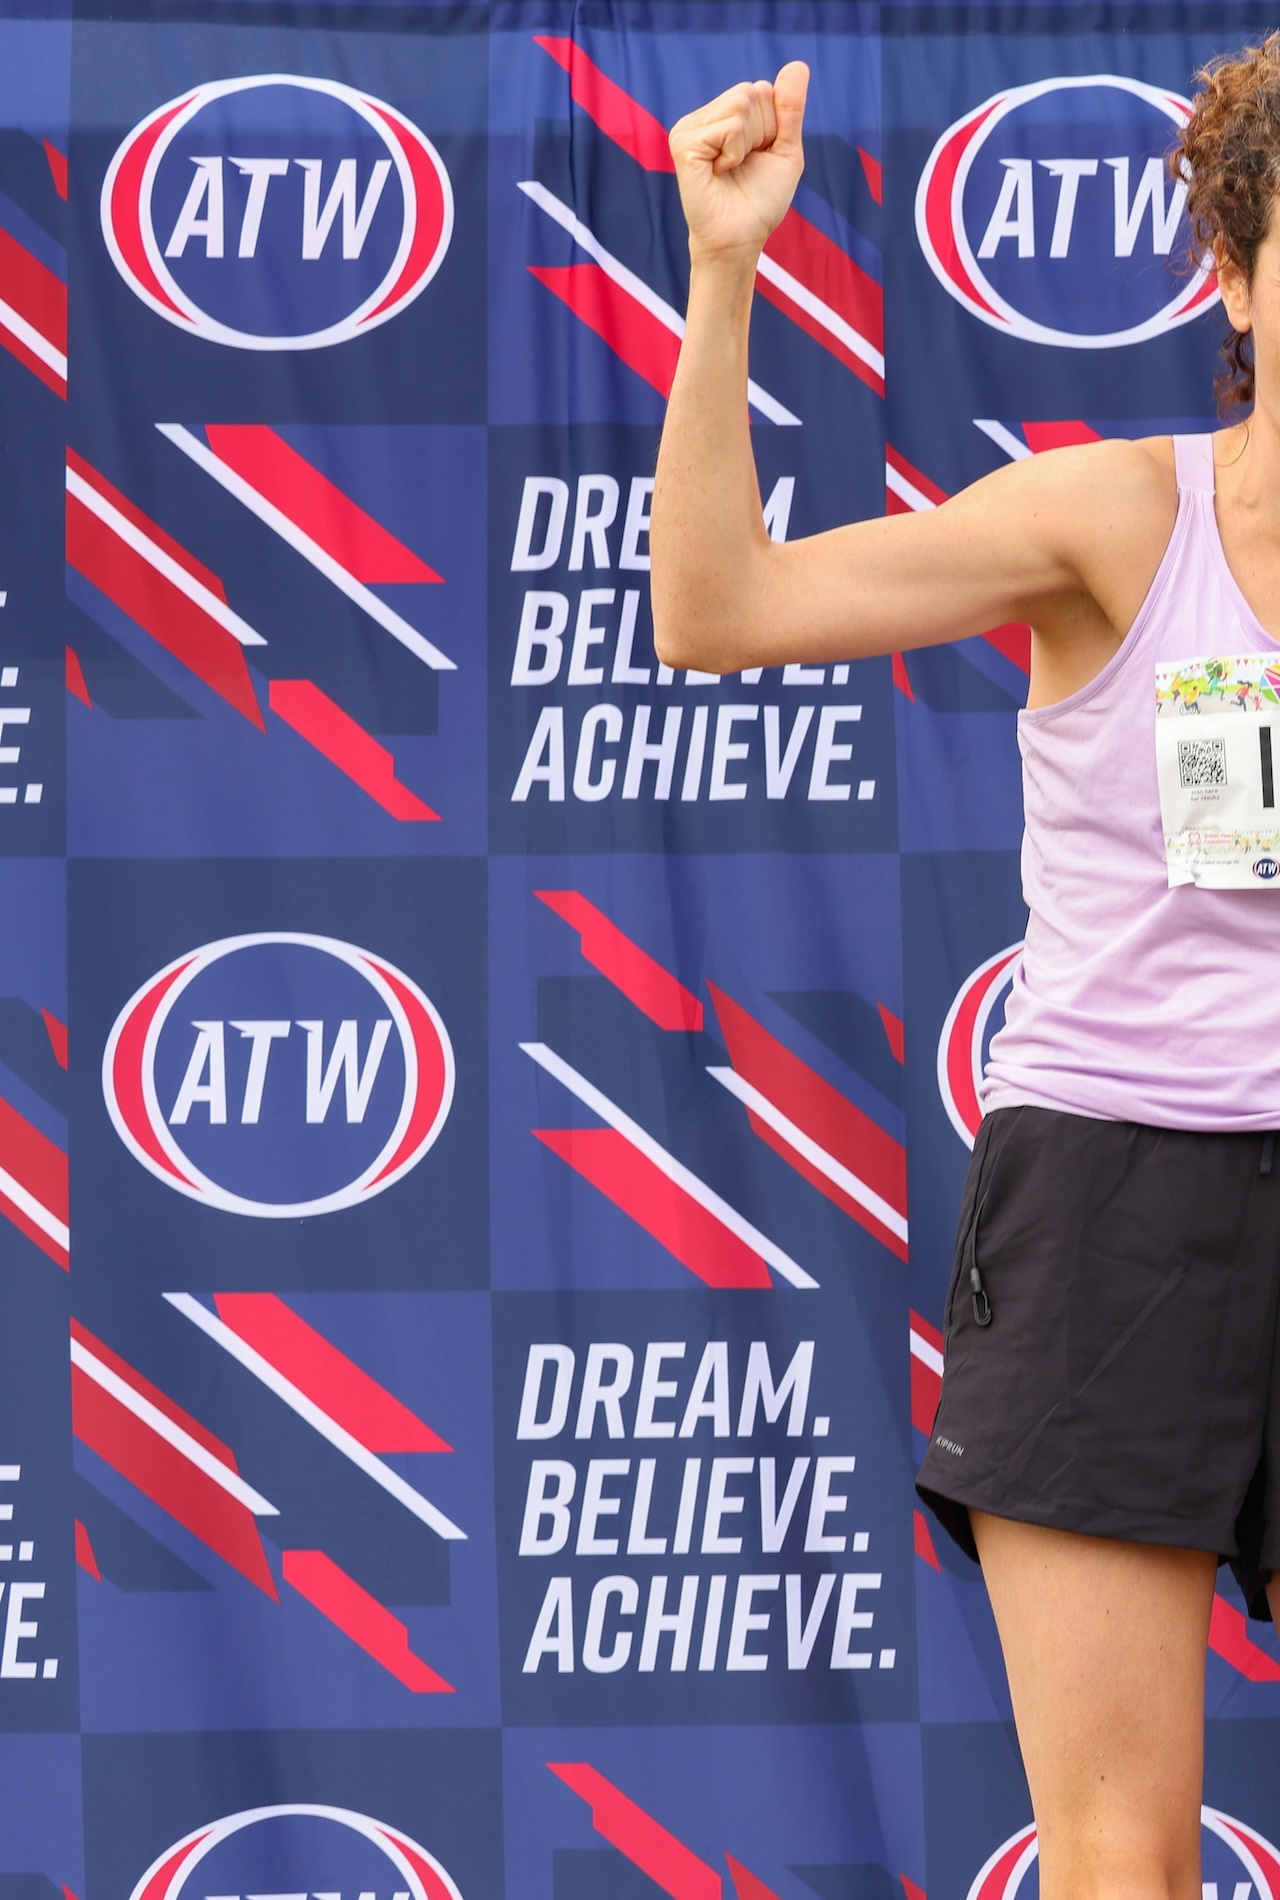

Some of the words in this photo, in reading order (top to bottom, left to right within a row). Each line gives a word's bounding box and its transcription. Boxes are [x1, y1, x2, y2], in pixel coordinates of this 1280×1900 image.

[164, 156, 392, 260] ATW
[977, 156, 1193, 259] ATW
[511, 703, 876, 802] ACHIEVE.
[1256, 864, 1278, 875] ATW
[169, 1019, 393, 1125] ATW
[516, 1341, 830, 1440] DREAM.
[935, 1435, 966, 1457] KIPRUN
[518, 1456, 870, 1556] BELIEVE.
[522, 1573, 897, 1673] ACHIEVE.
